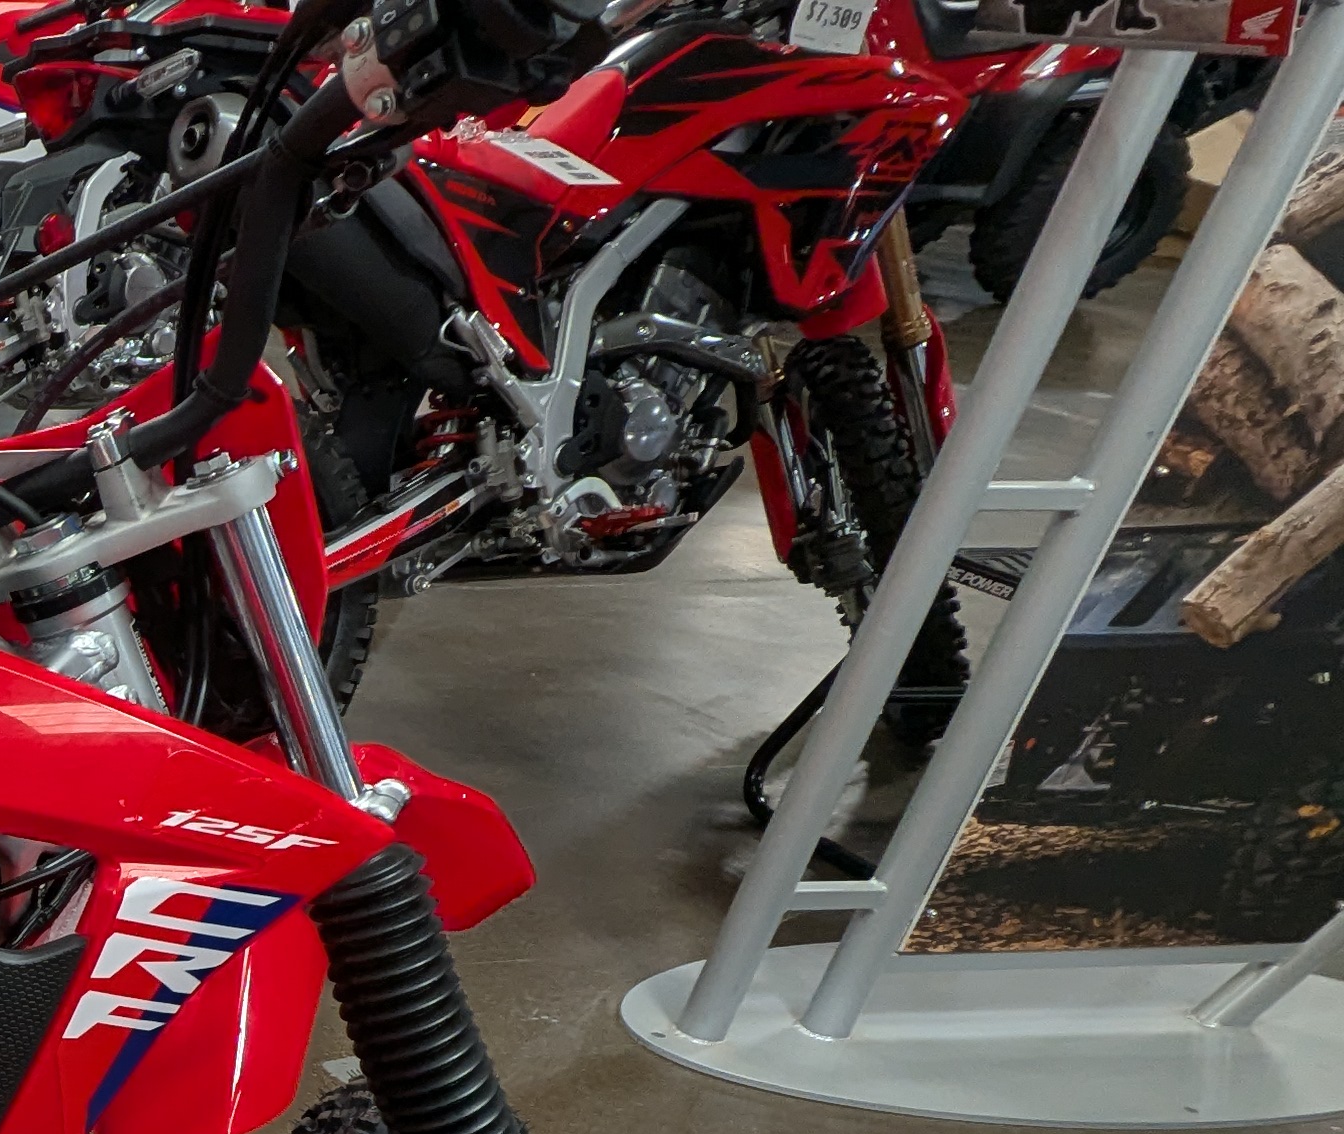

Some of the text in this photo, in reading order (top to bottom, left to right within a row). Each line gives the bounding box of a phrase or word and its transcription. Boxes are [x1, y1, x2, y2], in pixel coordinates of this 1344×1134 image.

[959, 571, 1014, 598] POWER
[160, 808, 310, 850] 125F
[62, 876, 282, 1039] CRF
